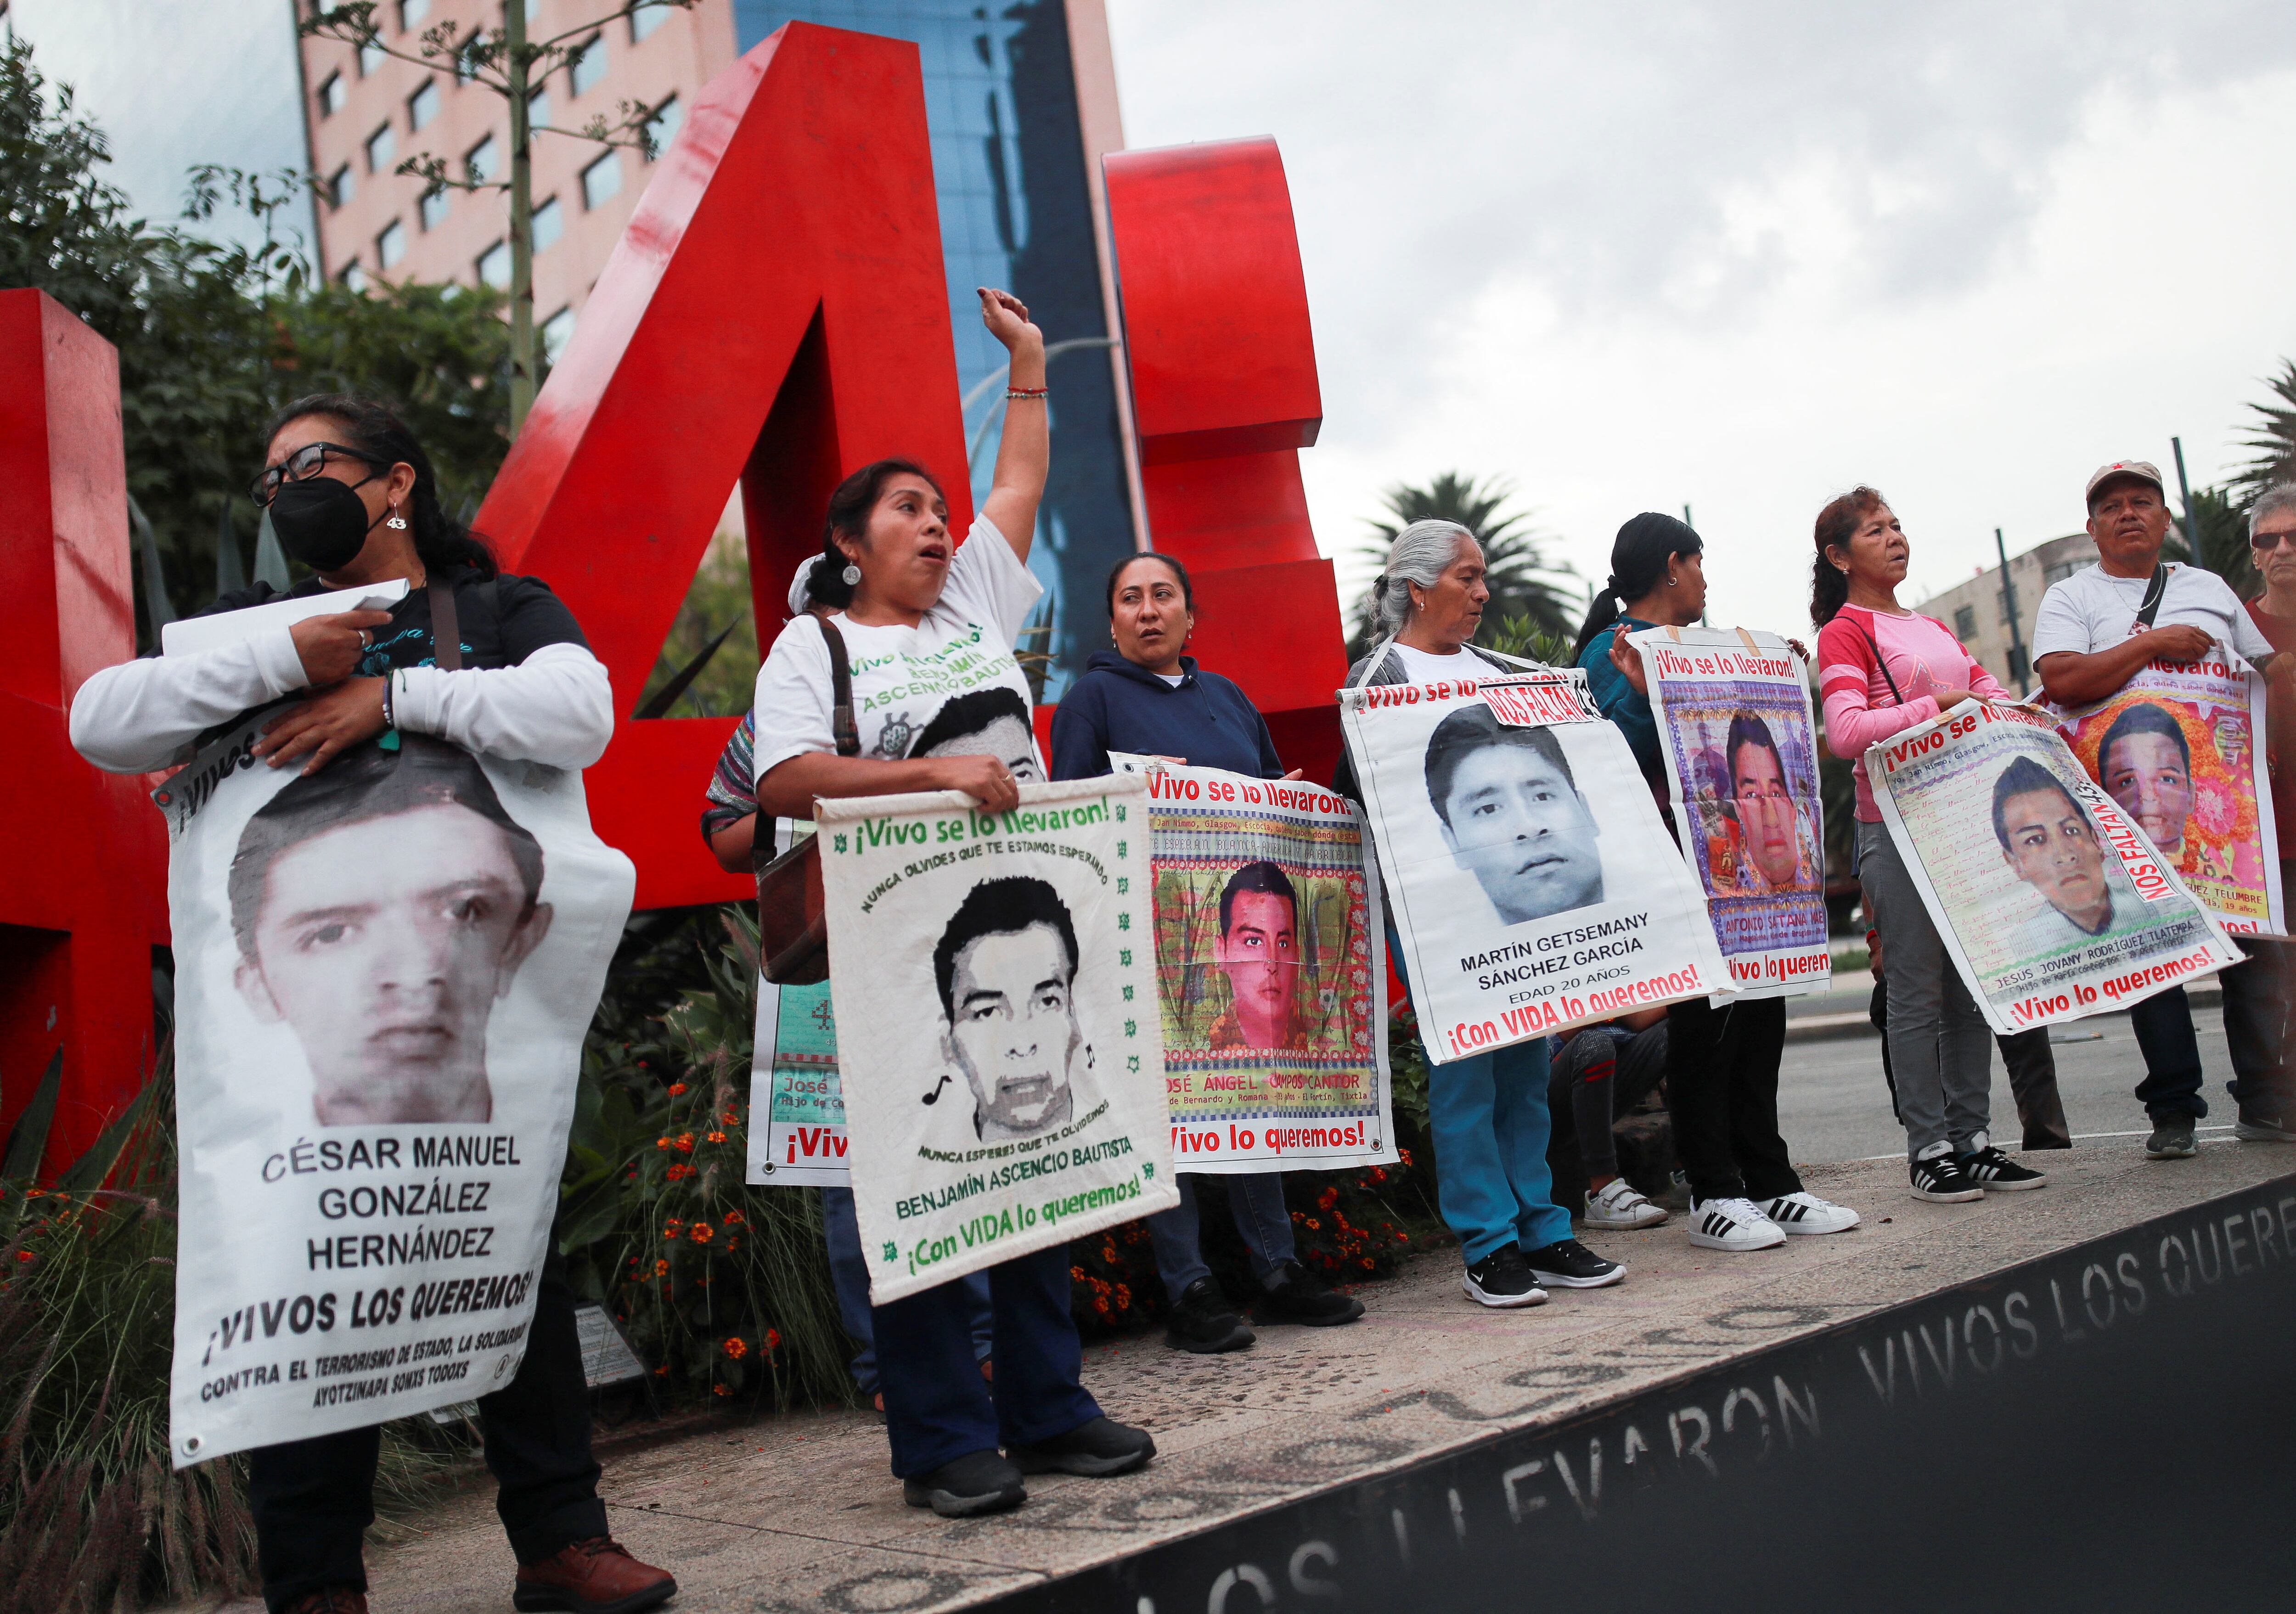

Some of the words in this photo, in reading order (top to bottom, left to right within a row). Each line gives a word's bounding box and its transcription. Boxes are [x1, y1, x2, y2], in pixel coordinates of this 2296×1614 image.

[386, 517, 407, 529] 43
[1656, 650, 1693, 680] ¡Vivo
[1695, 658, 1715, 675] se
[1714, 652, 1734, 675] lo
[1732, 652, 1795, 679] llevaron!
[1425, 681, 1451, 702] se
[1457, 680, 1476, 697] lo
[1885, 731, 1944, 773] ¡Vivo
[1949, 715, 1976, 739] se
[1980, 705, 2000, 724] lo
[1908, 769, 1922, 778] Jan
[1925, 760, 1951, 771] Nimmo,
[1955, 742, 1989, 759] Glasgow,
[1208, 782, 1236, 803] se
[1240, 781, 1261, 804] lo
[1262, 782, 1352, 816] llevaron!
[856, 816, 928, 855] ¡Vivo
[936, 820, 964, 843] se
[969, 809, 995, 839] lo
[1001, 795, 1109, 835] llevaron!
[1164, 838, 1210, 850] ESPERAN
[1173, 819, 1199, 829] Nimmo,
[1204, 820, 1241, 830] Glasgow,
[1245, 821, 1273, 832] Escocia,
[1313, 831, 1335, 839] dónde
[2088, 803, 2149, 861] FALTAN
[861, 873, 902, 915] NUNCA
[905, 851, 956, 878] OLVIDES
[959, 844, 982, 861] QUE
[986, 841, 1003, 854] TE
[1008, 841, 1056, 854] ESTAMOS
[1059, 844, 1109, 886] ESPERANDO
[2128, 864, 2172, 900] NOS
[2215, 888, 2262, 904] TELUMBRE
[2239, 905, 2257, 913] años
[1461, 942, 1532, 972] MARTÍN
[1536, 912, 1649, 953] GETSEMANY
[1995, 968, 2033, 989] JESÚS
[2040, 953, 2081, 974] JOVANY
[2087, 934, 2145, 960] RODRÍGUEZ
[2148, 920, 2195, 941] TLATEMPA
[1478, 956, 1568, 990] SÁNCHEZ
[1573, 937, 1643, 966] GARCÍA
[1765, 955, 1777, 978] lo
[1509, 985, 1555, 1004] EDAD
[1561, 978, 1581, 992] 20
[1587, 965, 1631, 985] AÑOS
[2009, 994, 2070, 1027] ¡Vivo
[2073, 983, 2098, 1006] lo
[2102, 945, 2216, 1001] queremos!
[2020, 981, 2039, 992] Hijo
[2042, 977, 2052, 985] de
[1447, 1020, 1501, 1056] ¡Con
[1501, 1000, 1561, 1037] VIDA
[1560, 995, 1586, 1020] lo
[1589, 963, 1703, 1014] queremos!
[783, 1076, 827, 1094] José
[1184, 1096, 1223, 1104] Bernardo
[1227, 1096, 1233, 1104] y
[1238, 1094, 1268, 1102] Romana
[1310, 1092, 1335, 1102] Fortín,
[1204, 1073, 1257, 1091] ÁNGEL
[1269, 1072, 1304, 1089] CAMPOS
[1308, 1074, 1360, 1089] CANTOR
[813, 1097, 826, 1107] de
[918, 1146, 964, 1163] NUNCA
[1018, 1138, 1041, 1153] QUE
[1044, 1132, 1059, 1146] TE
[1061, 1099, 1109, 1139] OLVIDEMOS
[1229, 1124, 1255, 1150] lo
[1265, 1120, 1365, 1155] queremos!
[261, 1137, 401, 1184] CÉSAR
[412, 1136, 521, 1169] MANUEL
[896, 1174, 985, 1220] BENJAMÍN
[989, 1152, 1068, 1192] ASCENCIO
[1072, 1136, 1133, 1167] BAUTISTA
[318, 1177, 493, 1220] GONZÁLEZ
[907, 1236, 957, 1276] ¡Con
[959, 1212, 1014, 1248] VIDA
[1017, 1203, 1036, 1232] lo
[1041, 1172, 1142, 1226] queremos!
[307, 1224, 494, 1271] HERNÁNDEZ
[202, 1292, 337, 1367] ¡VIVOS
[350, 1286, 405, 1329] LOS
[411, 1270, 533, 1322] QUEREMOS!
[1858, 1291, 2038, 1406] VIVOS
[2050, 1252, 2148, 1342] LOS
[200, 1362, 281, 1403] CONTRA
[288, 1360, 309, 1382] EL
[315, 1347, 395, 1378] TERRORISMO
[396, 1344, 412, 1365] DE
[412, 1337, 453, 1361] ESTADO,
[457, 1334, 473, 1354] LA
[313, 1378, 388, 1408] AYOTZINAPA
